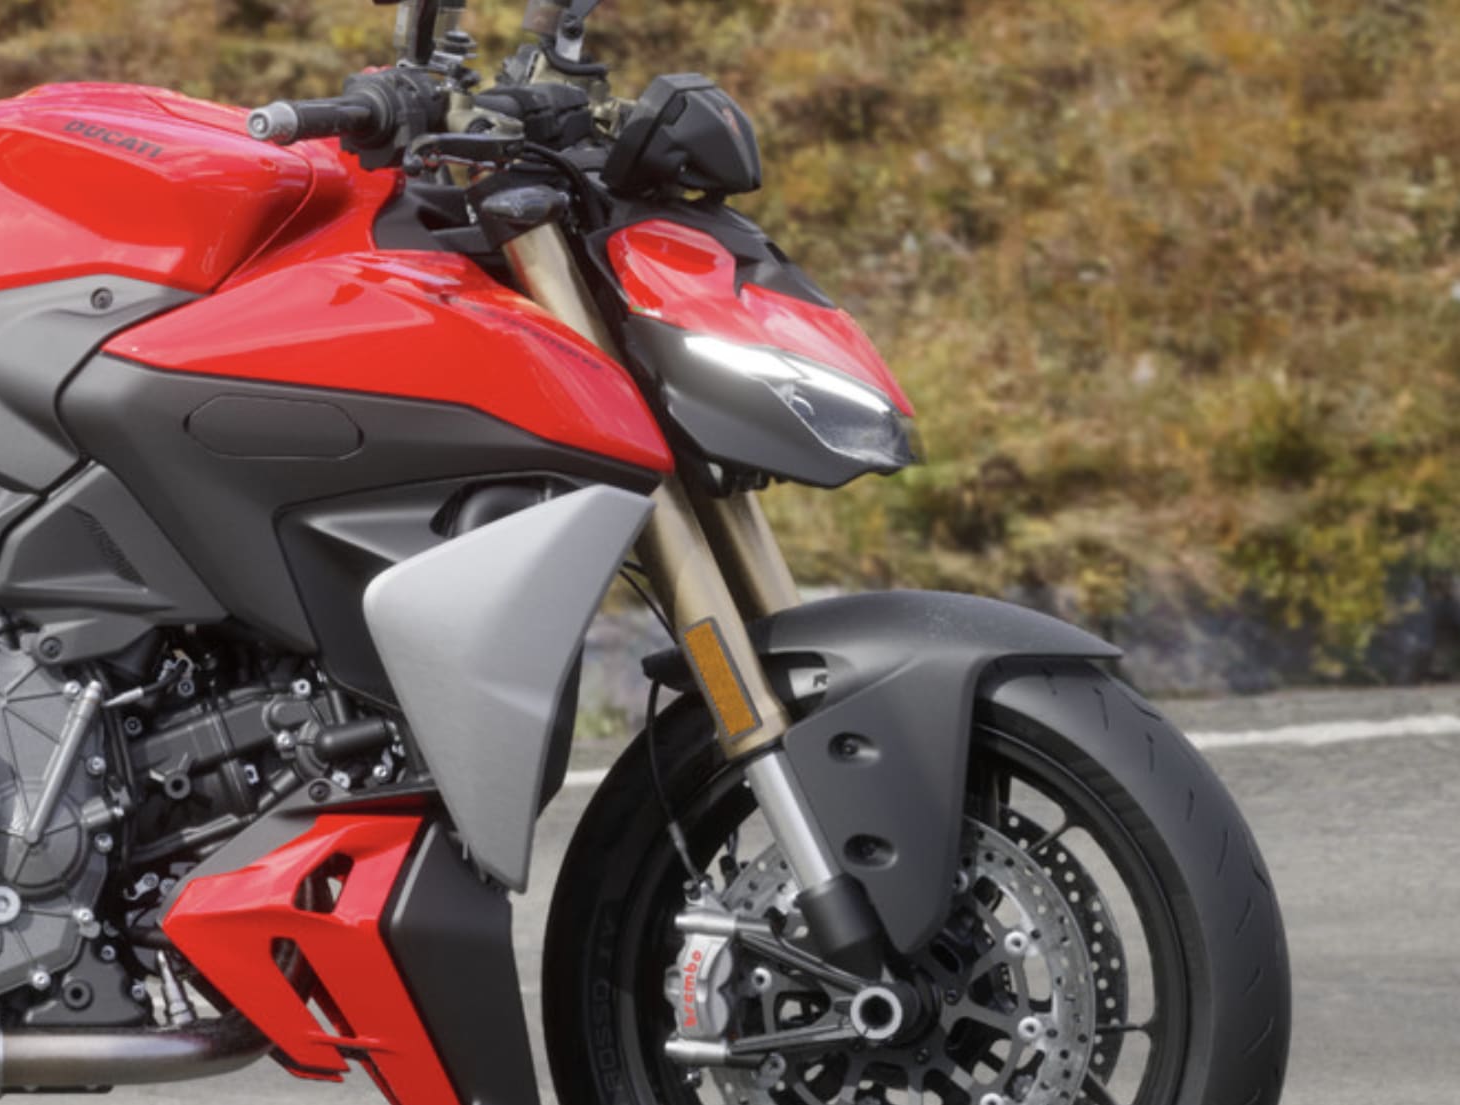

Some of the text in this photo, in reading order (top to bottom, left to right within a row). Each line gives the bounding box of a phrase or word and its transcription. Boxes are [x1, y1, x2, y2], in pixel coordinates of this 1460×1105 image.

[64, 119, 163, 158] DUCATI
[682, 949, 702, 1028] brembo
[592, 978, 619, 1092] ROSSO
